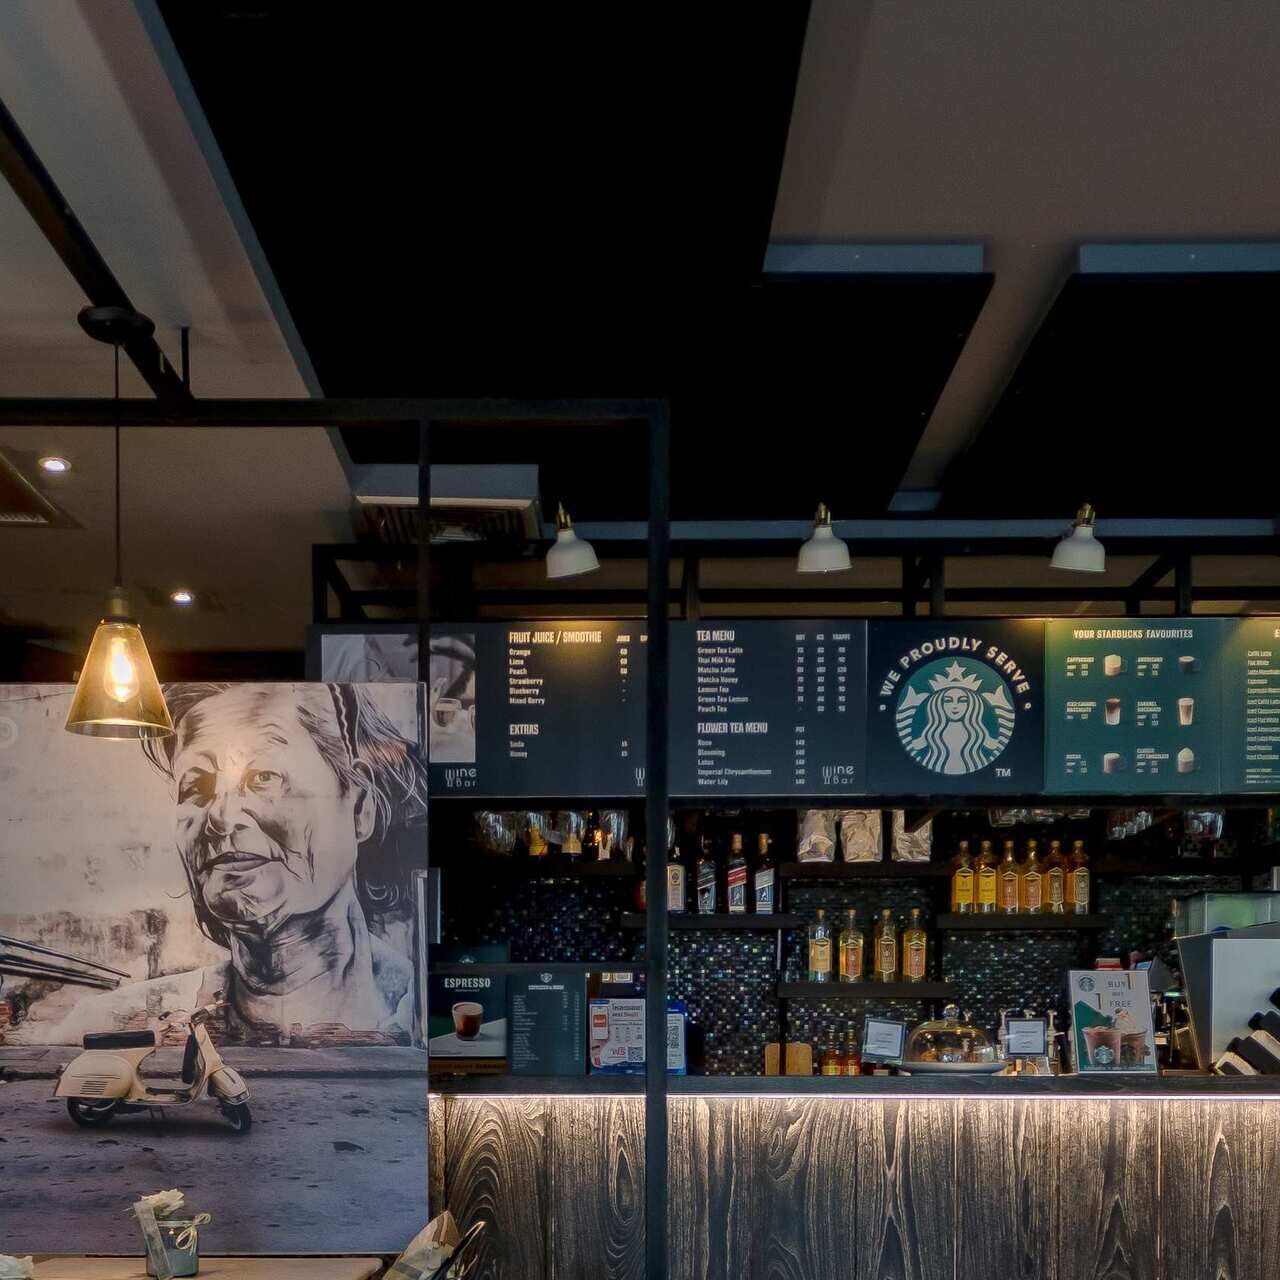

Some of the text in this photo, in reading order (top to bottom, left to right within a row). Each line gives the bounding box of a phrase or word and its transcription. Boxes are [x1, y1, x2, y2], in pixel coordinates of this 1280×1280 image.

[508, 631, 531, 643] FRUIT
[532, 631, 555, 643] JUICE
[563, 631, 602, 643] SMOOTHIE
[697, 630, 735, 641] TEA MENU
[1073, 629, 1193, 639] YOUR STARBUCKS FAVOURITES
[880, 636, 1030, 697] WE PROUDLY SERVE
[509, 723, 540, 735] EXTRAS
[697, 722, 768, 734] FLOWER TEA MENU
[995, 768, 1012, 777] TM
[444, 977, 492, 988] ESPRESSO
[1109, 1000, 1135, 1008] FREE
